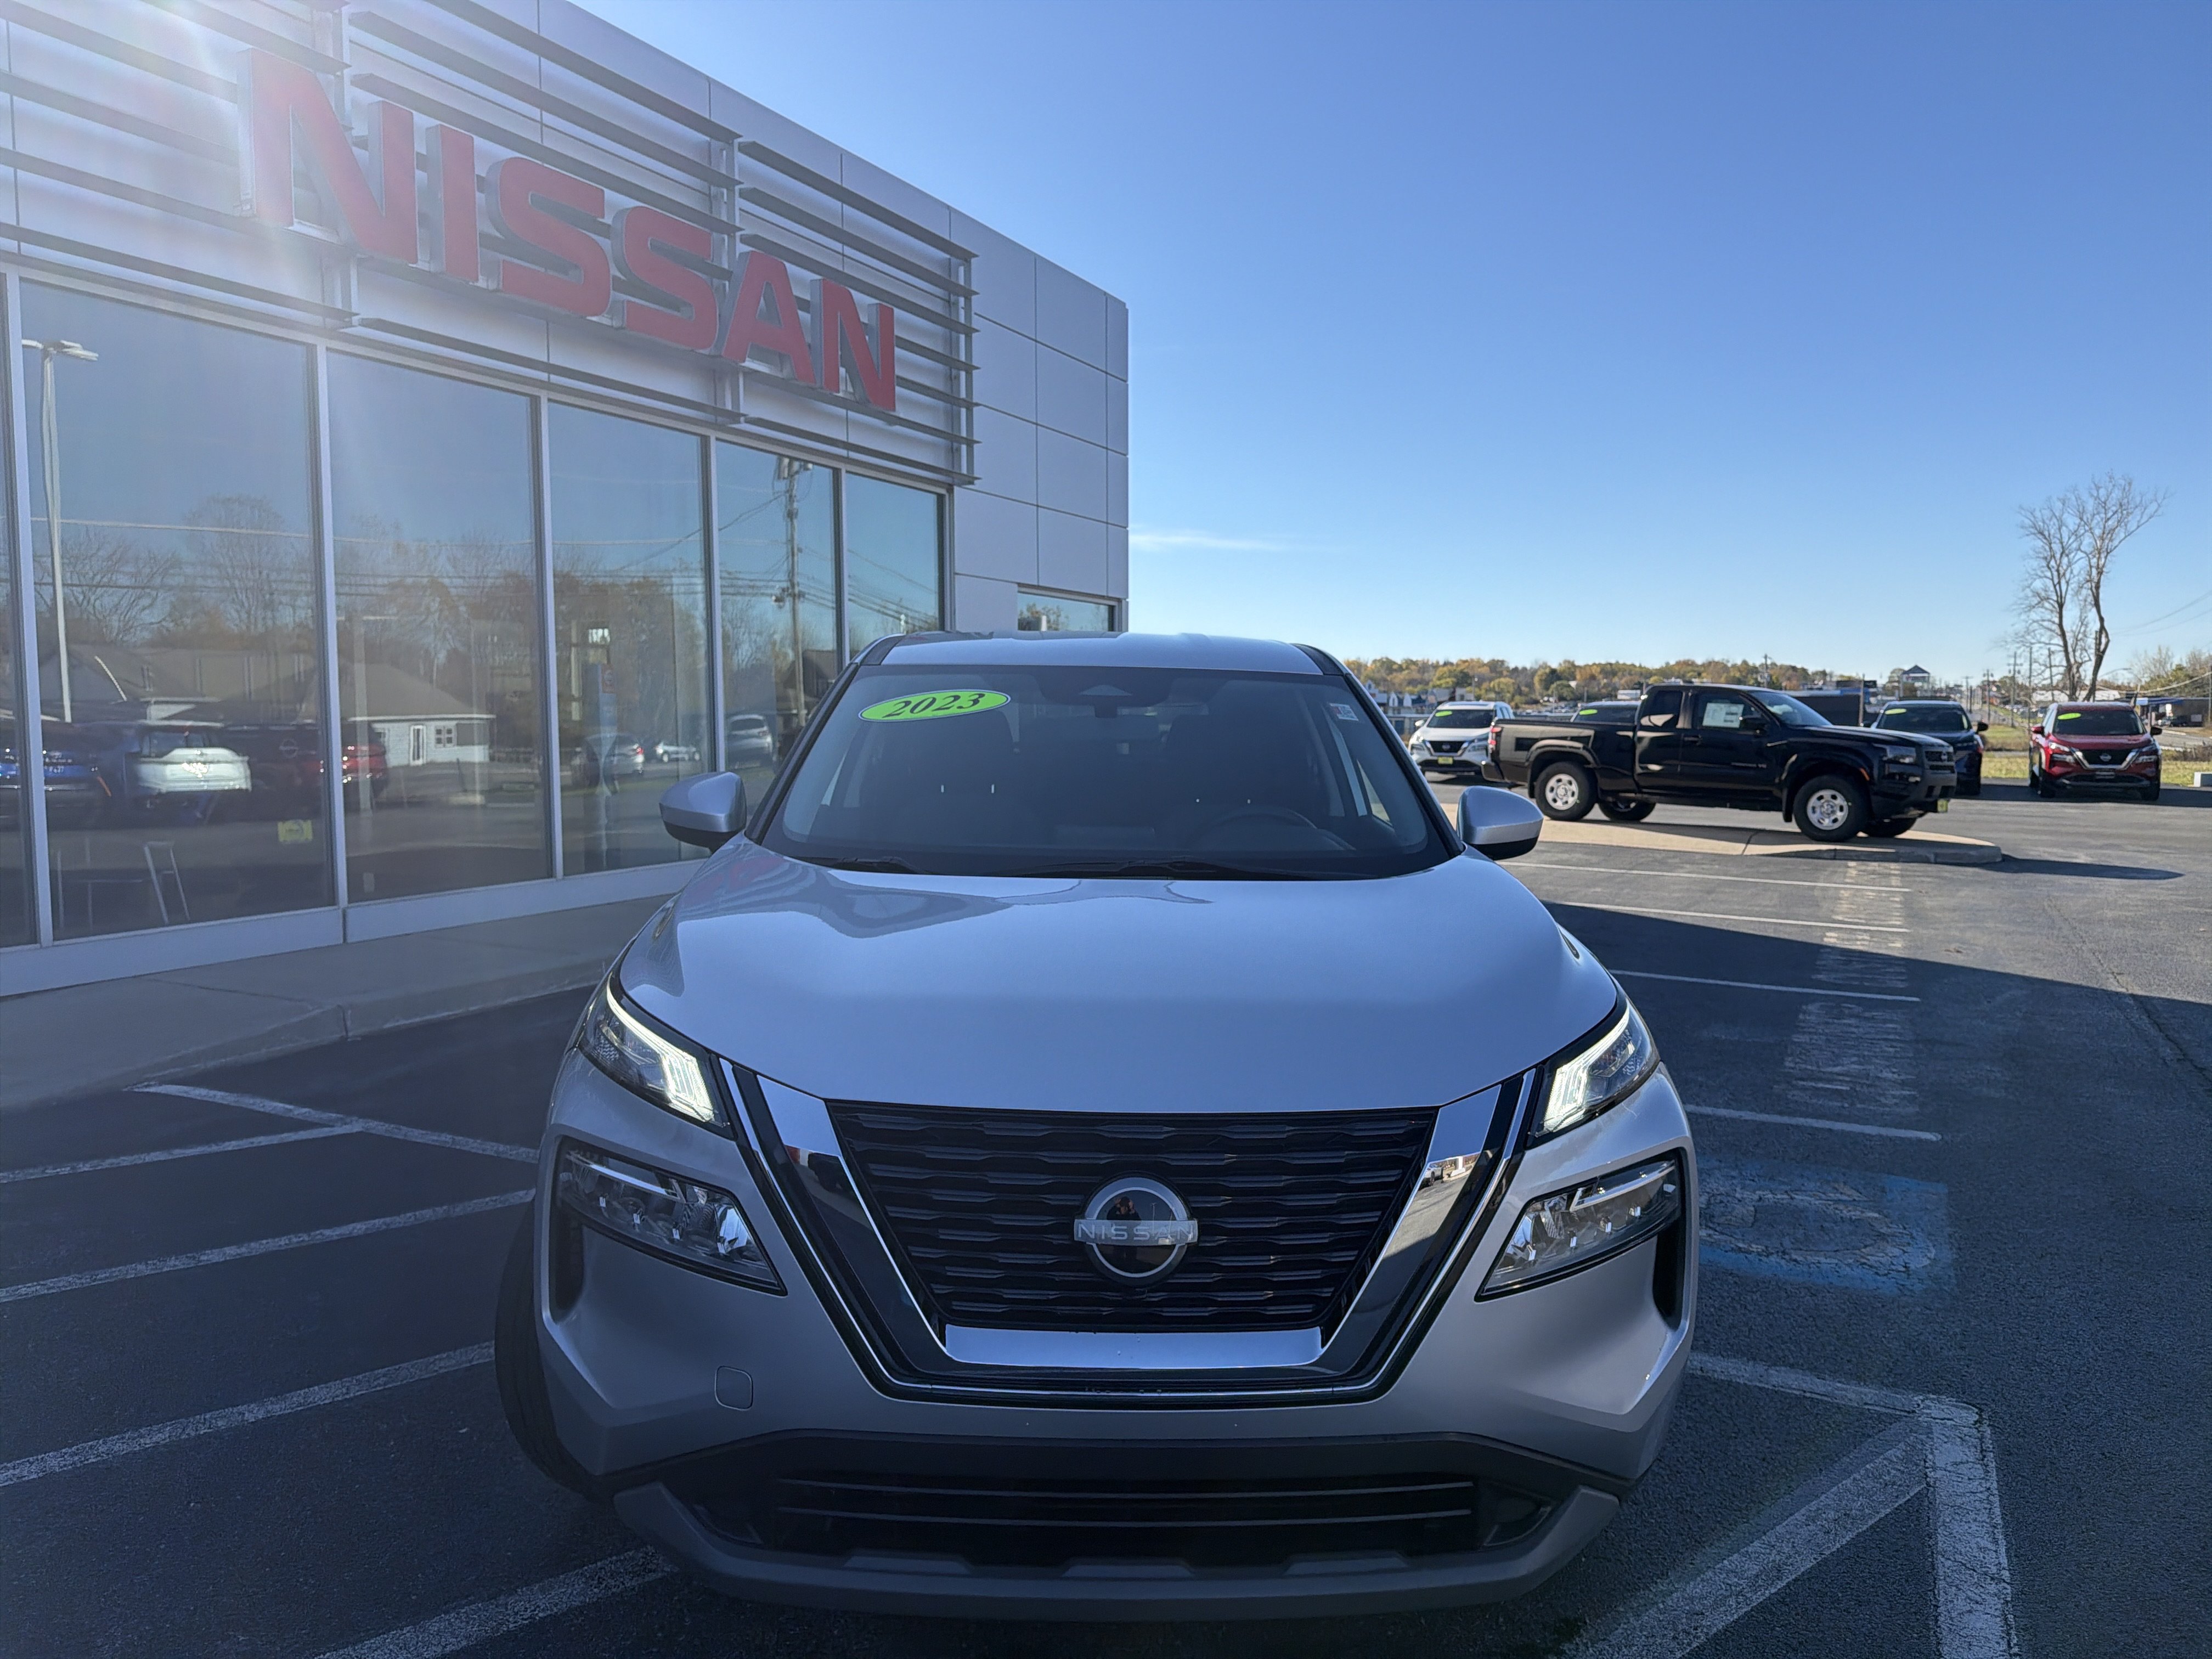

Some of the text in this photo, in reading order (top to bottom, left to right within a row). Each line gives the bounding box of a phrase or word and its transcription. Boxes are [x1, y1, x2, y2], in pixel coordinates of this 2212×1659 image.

[239, 47, 896, 412] NISSAN
[882, 693, 985, 719] 2023
[1078, 1223, 1193, 1240] NISSAN
